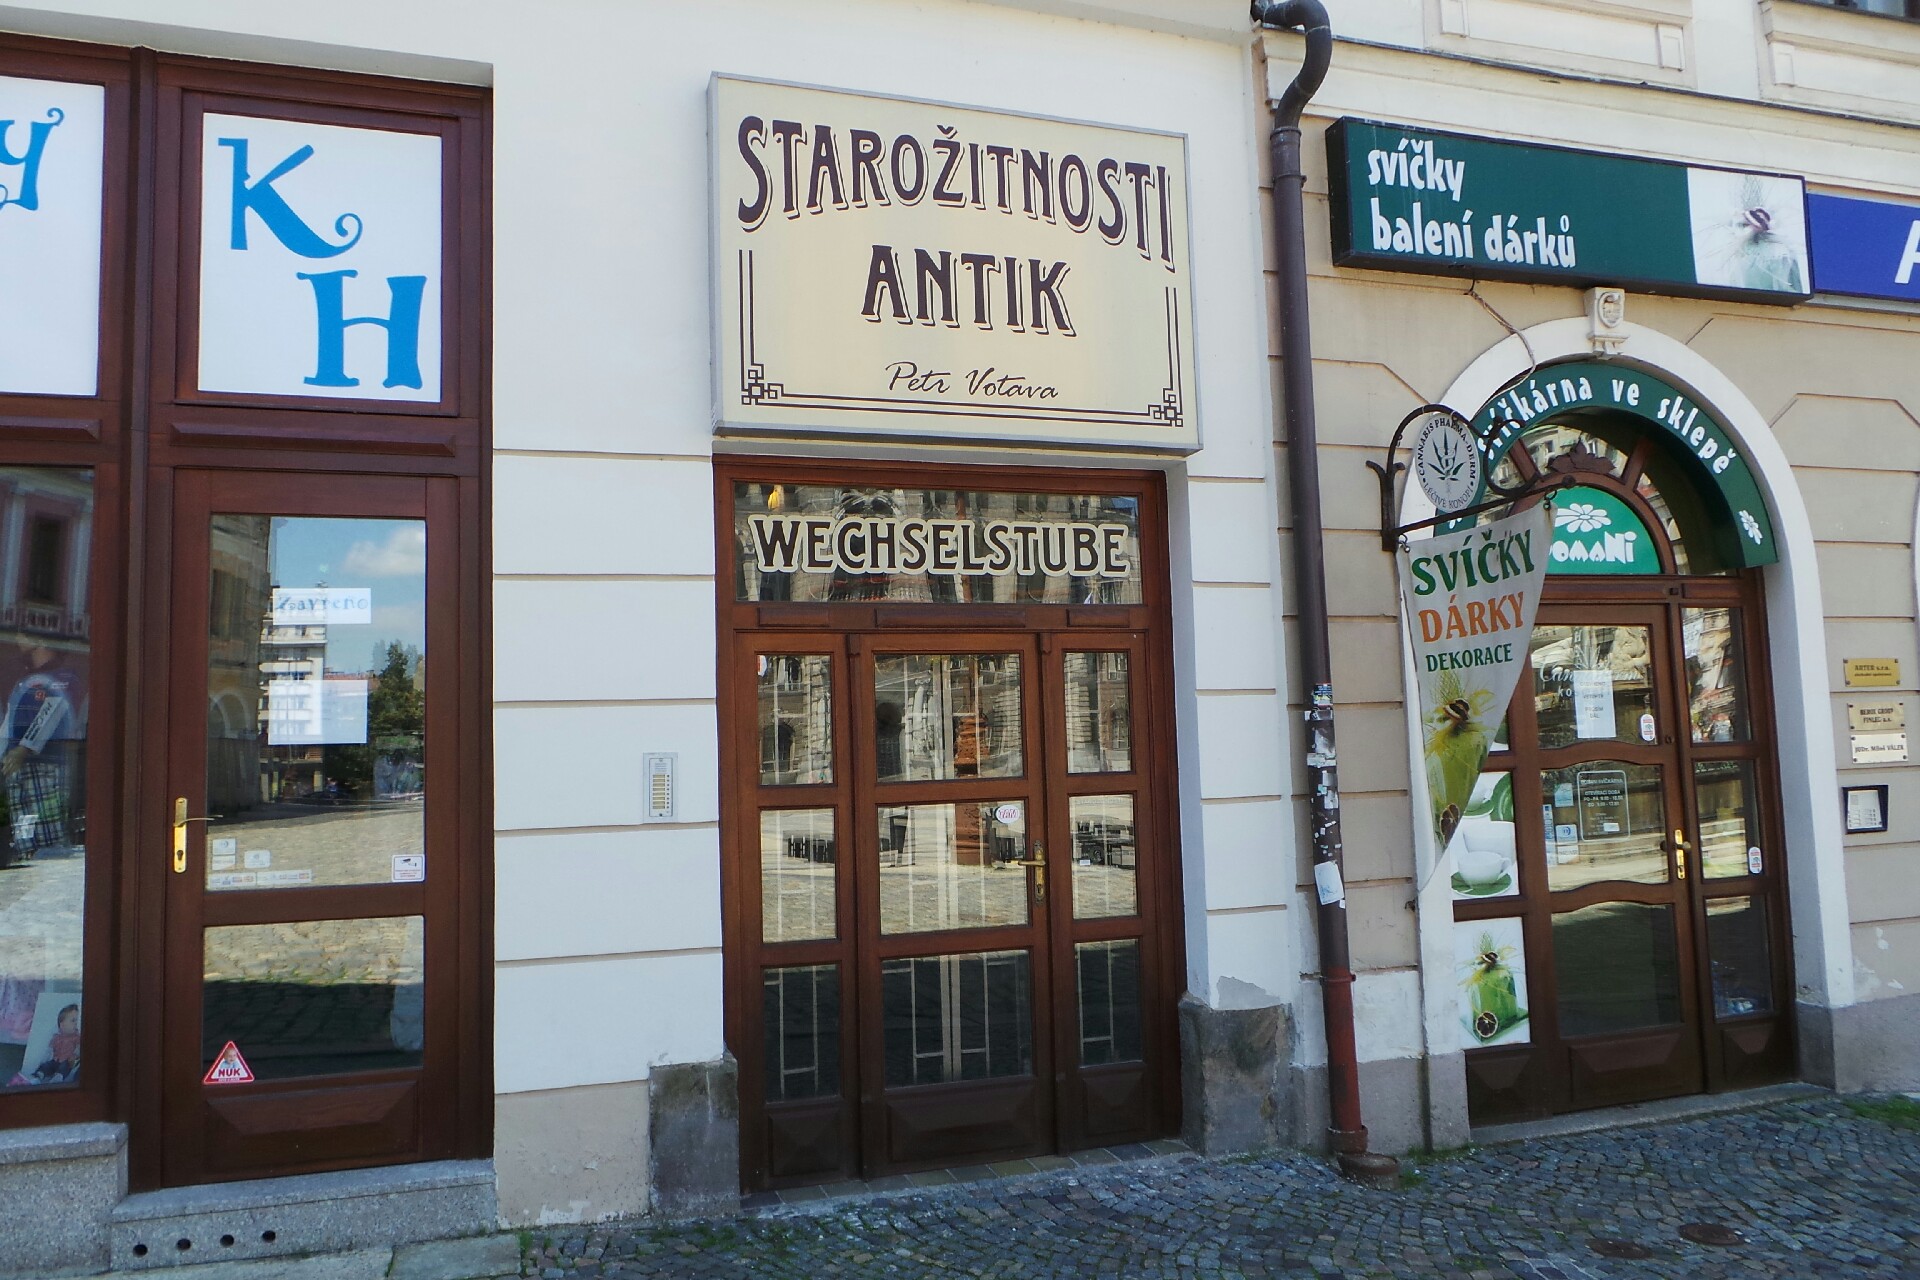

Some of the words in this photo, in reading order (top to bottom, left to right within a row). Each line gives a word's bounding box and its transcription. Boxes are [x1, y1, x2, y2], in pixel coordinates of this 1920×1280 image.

[738, 115, 1176, 274] STAROŽITNOSTI
[1367, 137, 1466, 202] svíčky
[1370, 197, 1474, 259] balení
[1484, 214, 1576, 268] dárků
[861, 244, 1077, 337] ANTIK
[885, 361, 951, 394] Petr
[965, 367, 1058, 399] Votava
[1417, 421, 1435, 477] CANNABIS
[1612, 379, 1640, 406] ve
[1657, 396, 1738, 474] sklepě
[748, 514, 1130, 577] WECHSELSTUBE
[1411, 528, 1535, 596] SVÍČKY
[1418, 591, 1524, 643] DÁRKY
[1425, 643, 1513, 672] DEKORACE
[218, 1068, 241, 1078] NUK
